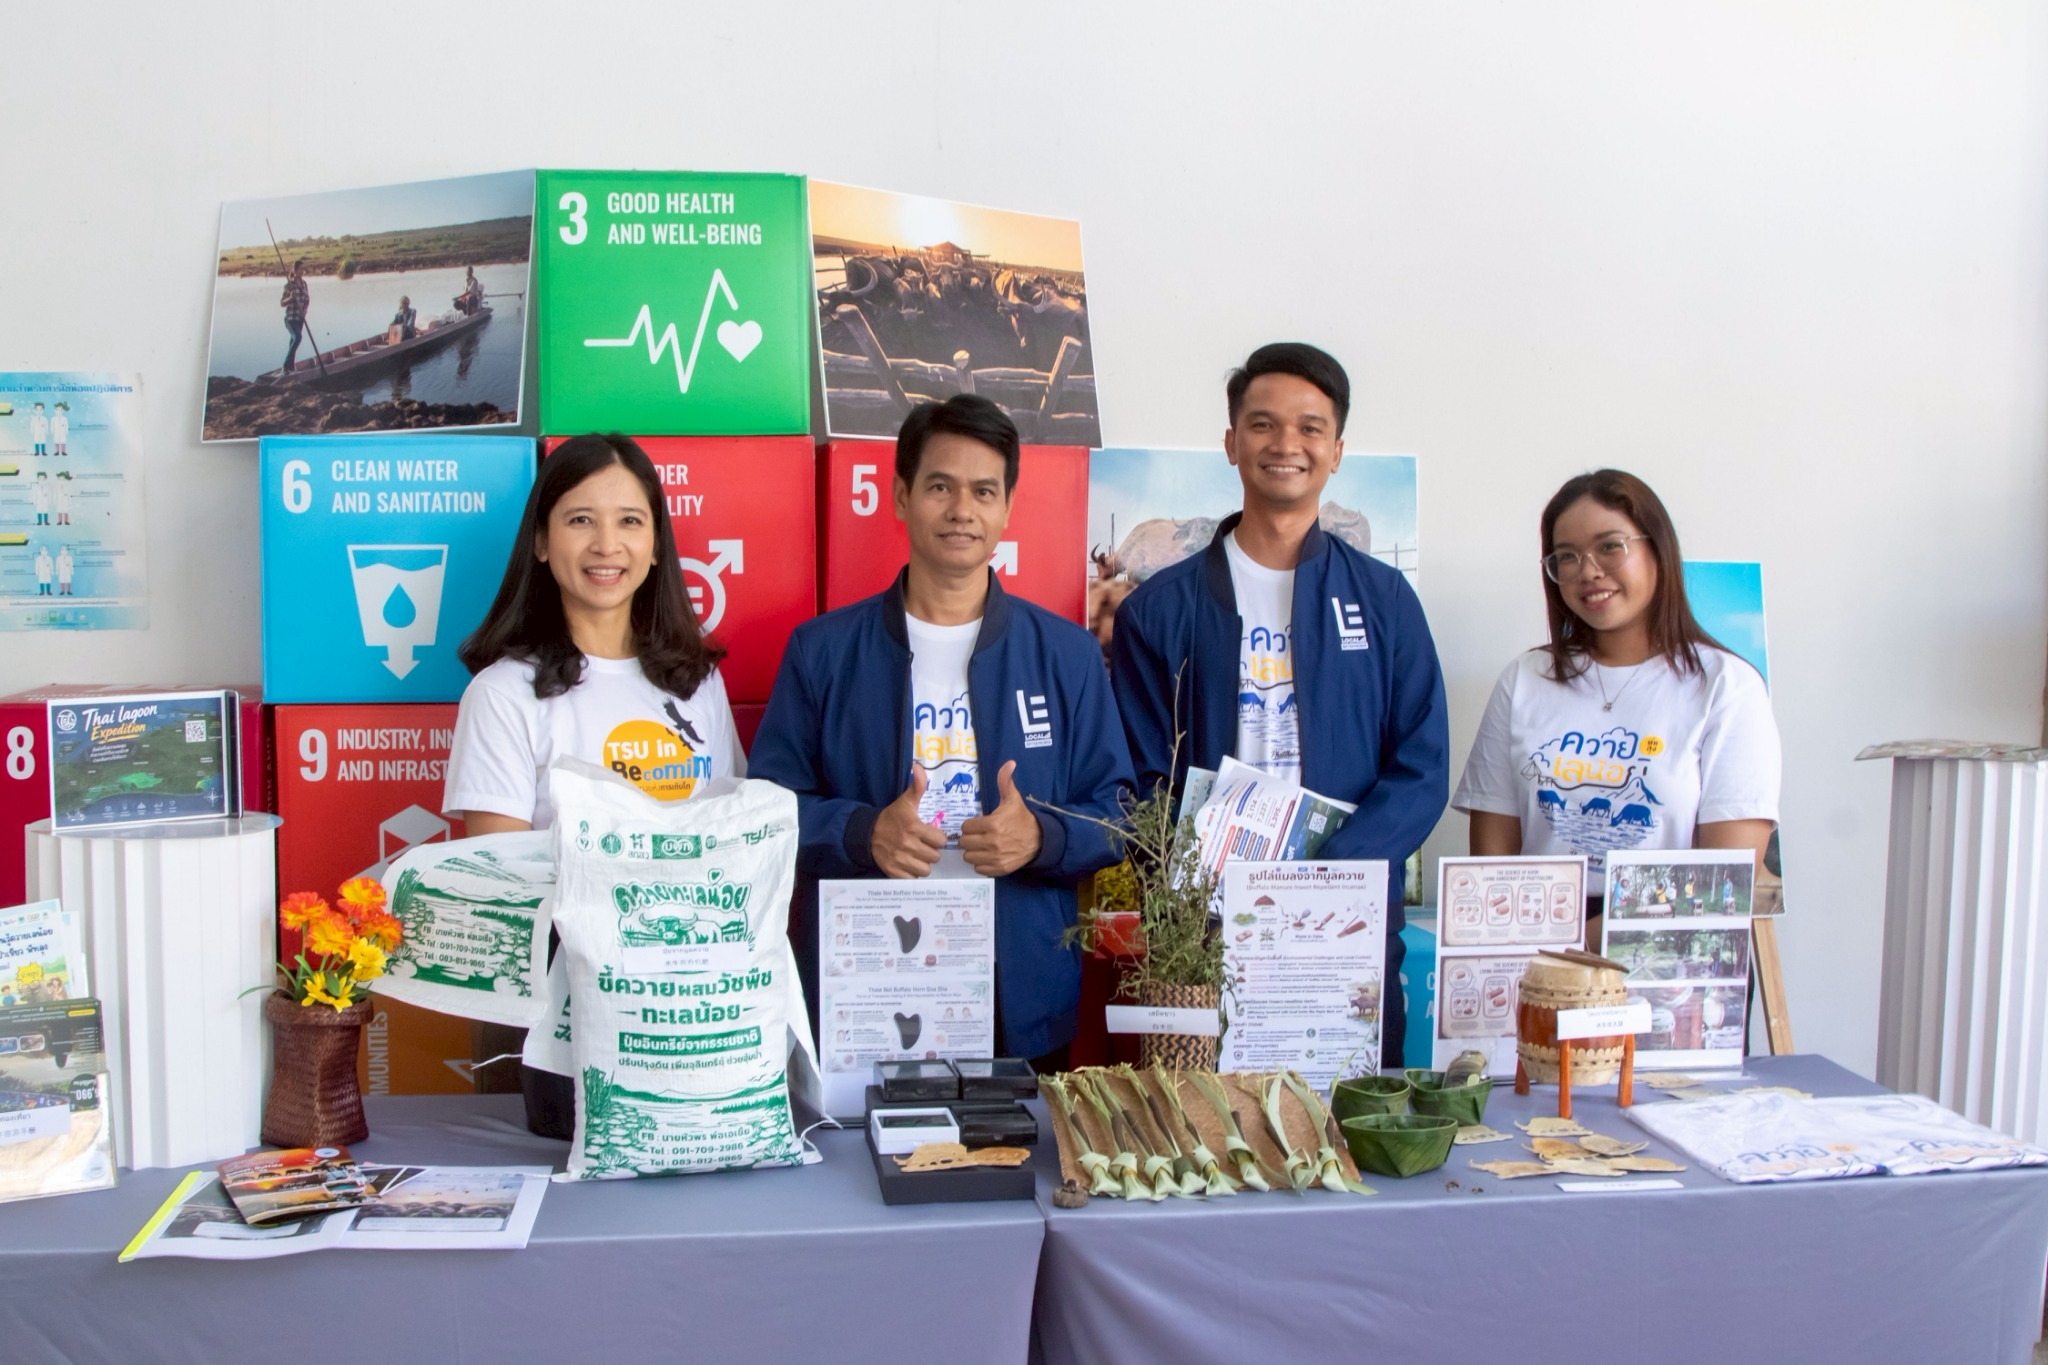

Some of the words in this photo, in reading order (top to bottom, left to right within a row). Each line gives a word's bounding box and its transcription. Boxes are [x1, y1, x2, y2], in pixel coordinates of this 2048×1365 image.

[607, 192, 660, 214] GOOD
[666, 193, 735, 214] HEALTH
[558, 191, 588, 245] 3
[607, 223, 646, 245] AND
[652, 223, 762, 245] WELL-BEING
[331, 460, 390, 481] CLEAN
[396, 460, 459, 481] WATER
[659, 464, 689, 485] DER
[282, 459, 312, 514] 6
[851, 464, 879, 517] 5
[331, 492, 371, 513] AND
[377, 492, 486, 513] SANITATION
[668, 495, 704, 516] LITY
[82, 708, 115, 732] Thai
[914, 702, 970, 730] ควา
[91, 723, 147, 742] Expedition
[337, 729, 426, 752] INDUSTRY,
[6, 726, 36, 780] 8
[298, 728, 328, 782] 9
[607, 740, 649, 760] TSU
[656, 739, 678, 758] in
[915, 731, 978, 761] เลน้อ
[1559, 731, 1639, 759] ควาย
[337, 760, 374, 781] AND
[379, 760, 449, 781] INFRAST
[426, 939, 435, 948] Tel
[424, 952, 434, 960] Tel
[642, 1001, 741, 1024] ทะเลน้อย
[623, 1028, 759, 1052] ปุ๋ยอินทรีย์จากธรรมชาติ
[368, 1011, 390, 1095] MUNITIES
[641, 1132, 654, 1141] FB
[649, 1147, 665, 1155] Tel
[672, 1142, 744, 1155] 091-709-2986
